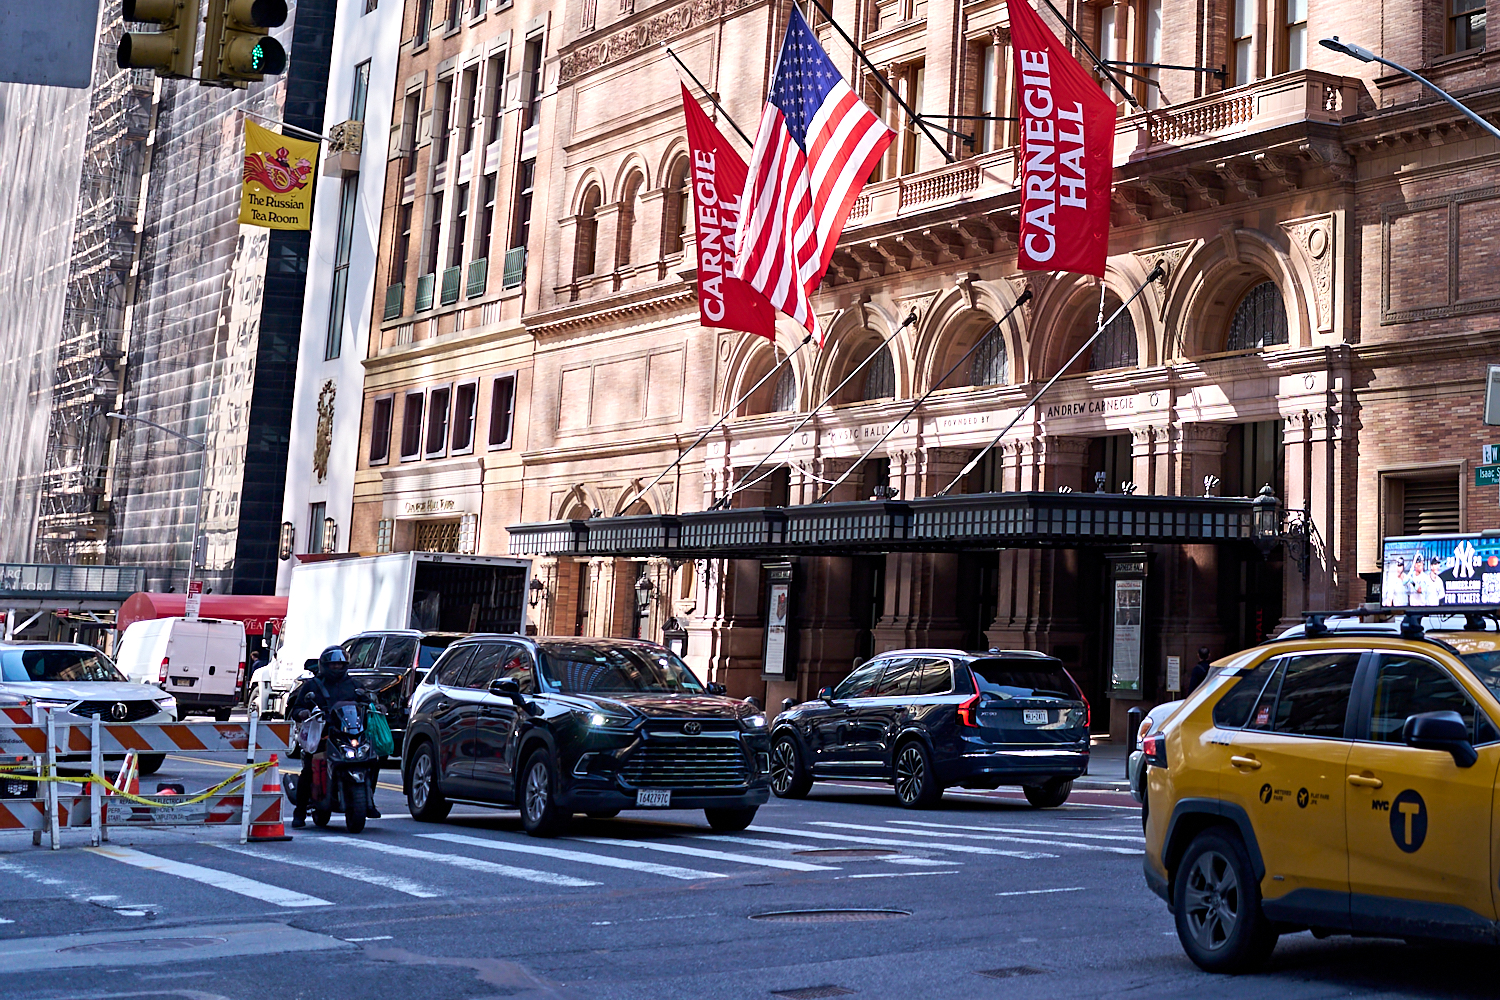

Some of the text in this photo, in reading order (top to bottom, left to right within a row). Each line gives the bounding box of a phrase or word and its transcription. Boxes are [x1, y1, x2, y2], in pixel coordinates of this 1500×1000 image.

[1021, 48, 1056, 262] CARNEGIE
[1057, 101, 1086, 210] HALL
[248, 193, 304, 210] The Russian
[251, 209, 299, 224] Tea Room
[694, 149, 725, 322] CARNEGIE
[1047, 398, 1134, 417] ANDREW CARNEGIE
[981, 415, 990, 424] BY
[1491, 446, 1498, 460] W
[1480, 469, 1495, 478] Isaac
[1444, 593, 1481, 603] FOR TICKETS
[242, 618, 263, 630] TEA
[1372, 799, 1420, 845] NYC T
